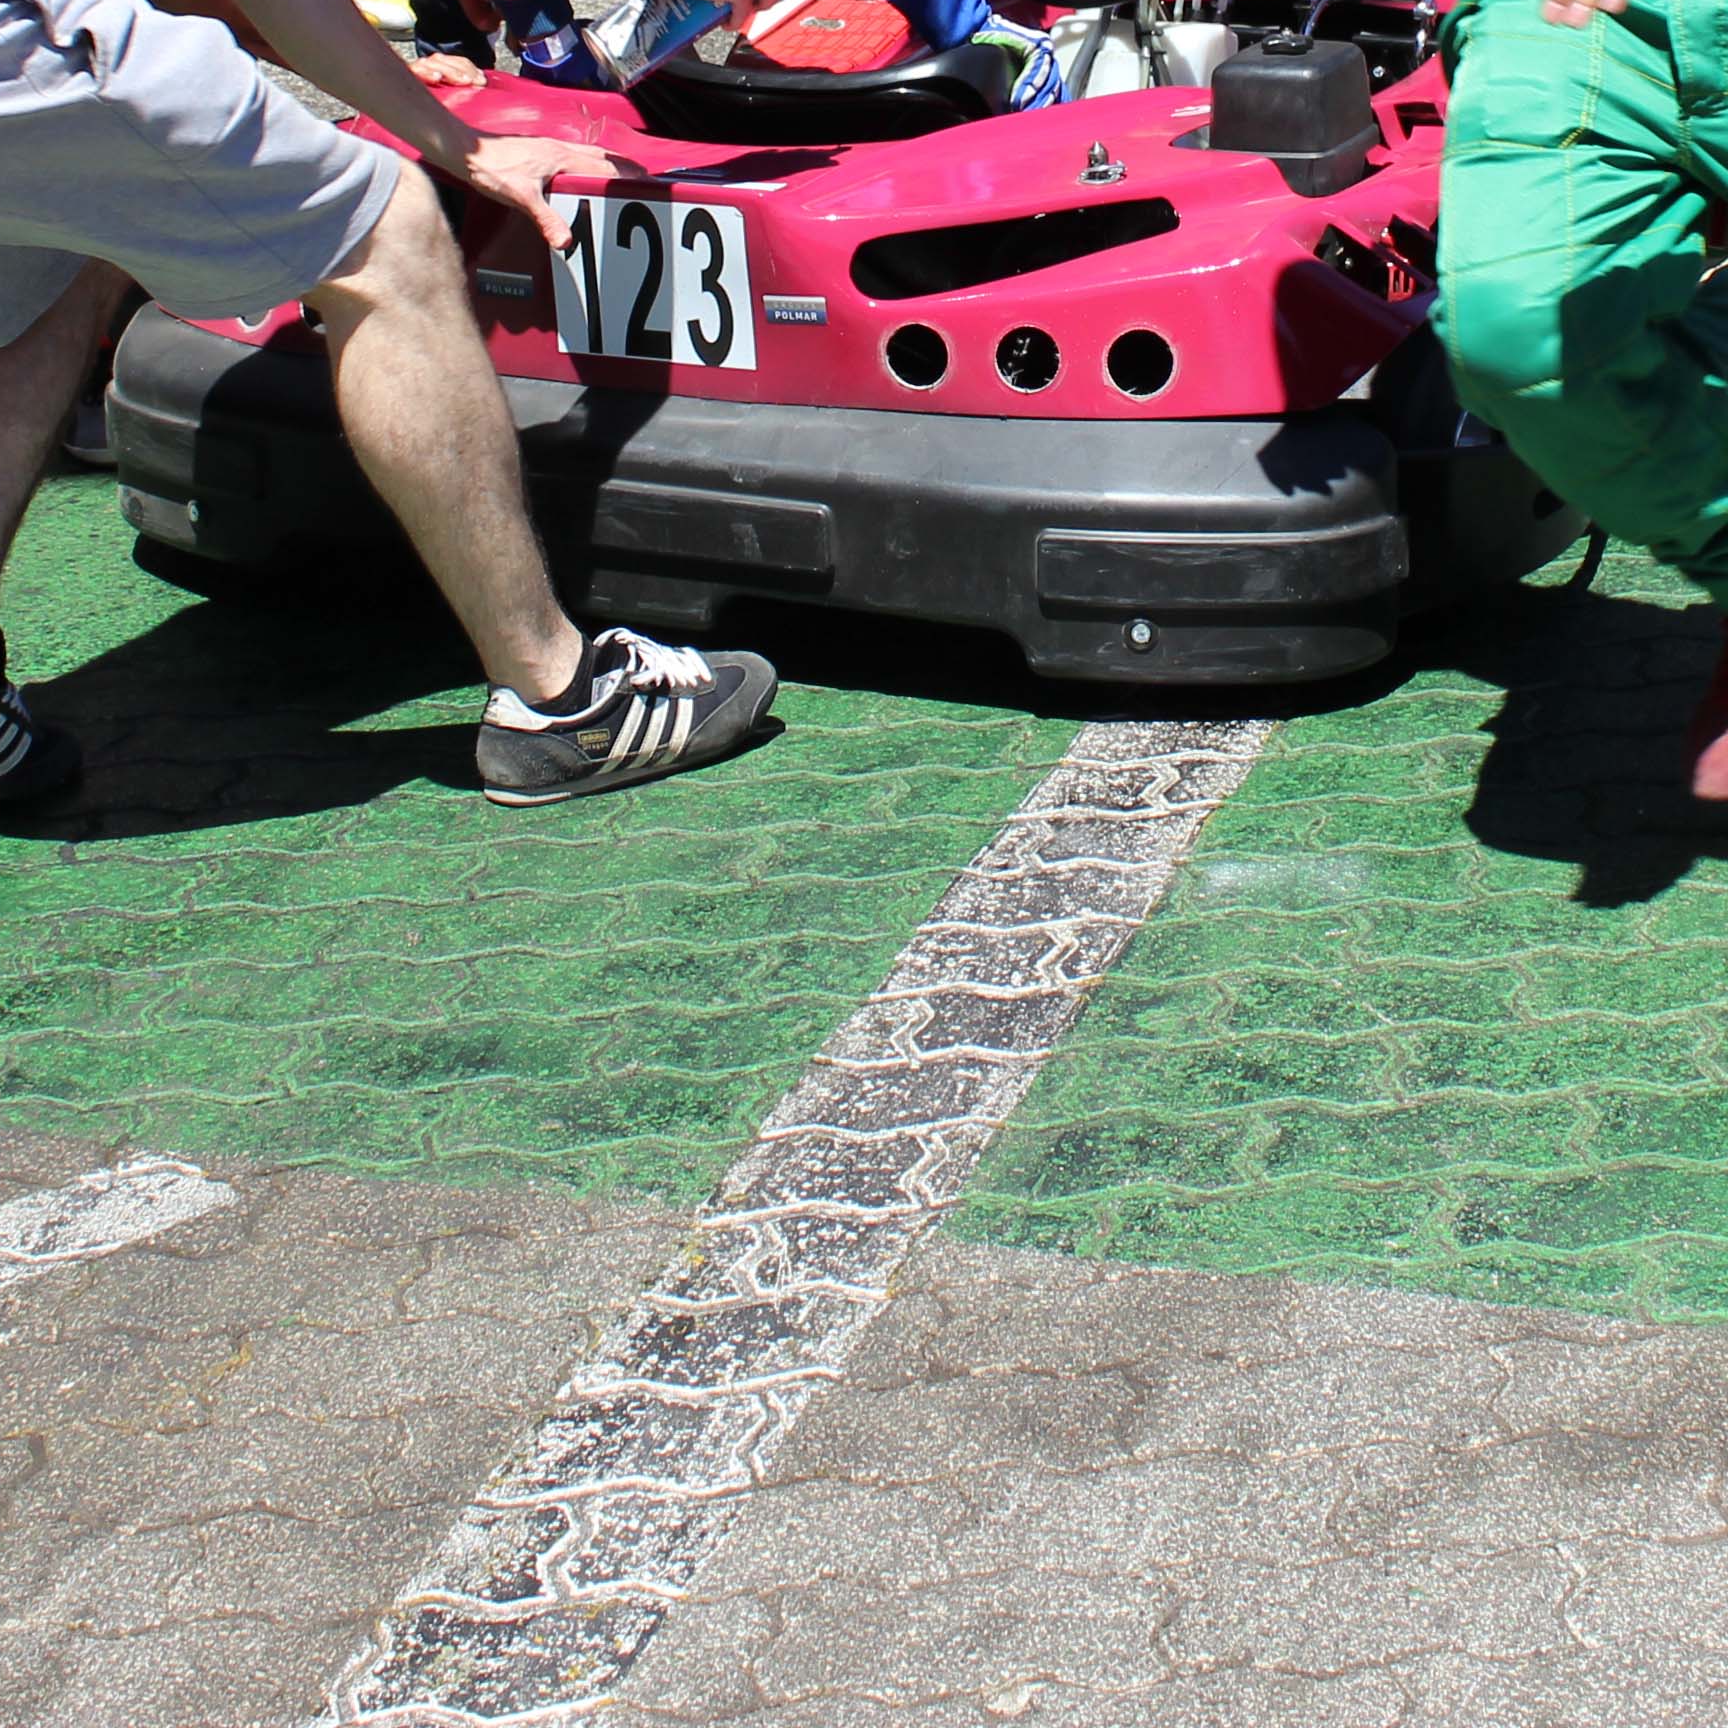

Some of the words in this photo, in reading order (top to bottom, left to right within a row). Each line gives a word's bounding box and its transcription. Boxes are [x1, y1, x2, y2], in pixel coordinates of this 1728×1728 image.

[484, 281, 526, 297] POLMAR
[564, 197, 735, 368] 123
[773, 310, 818, 321] POLMAR
